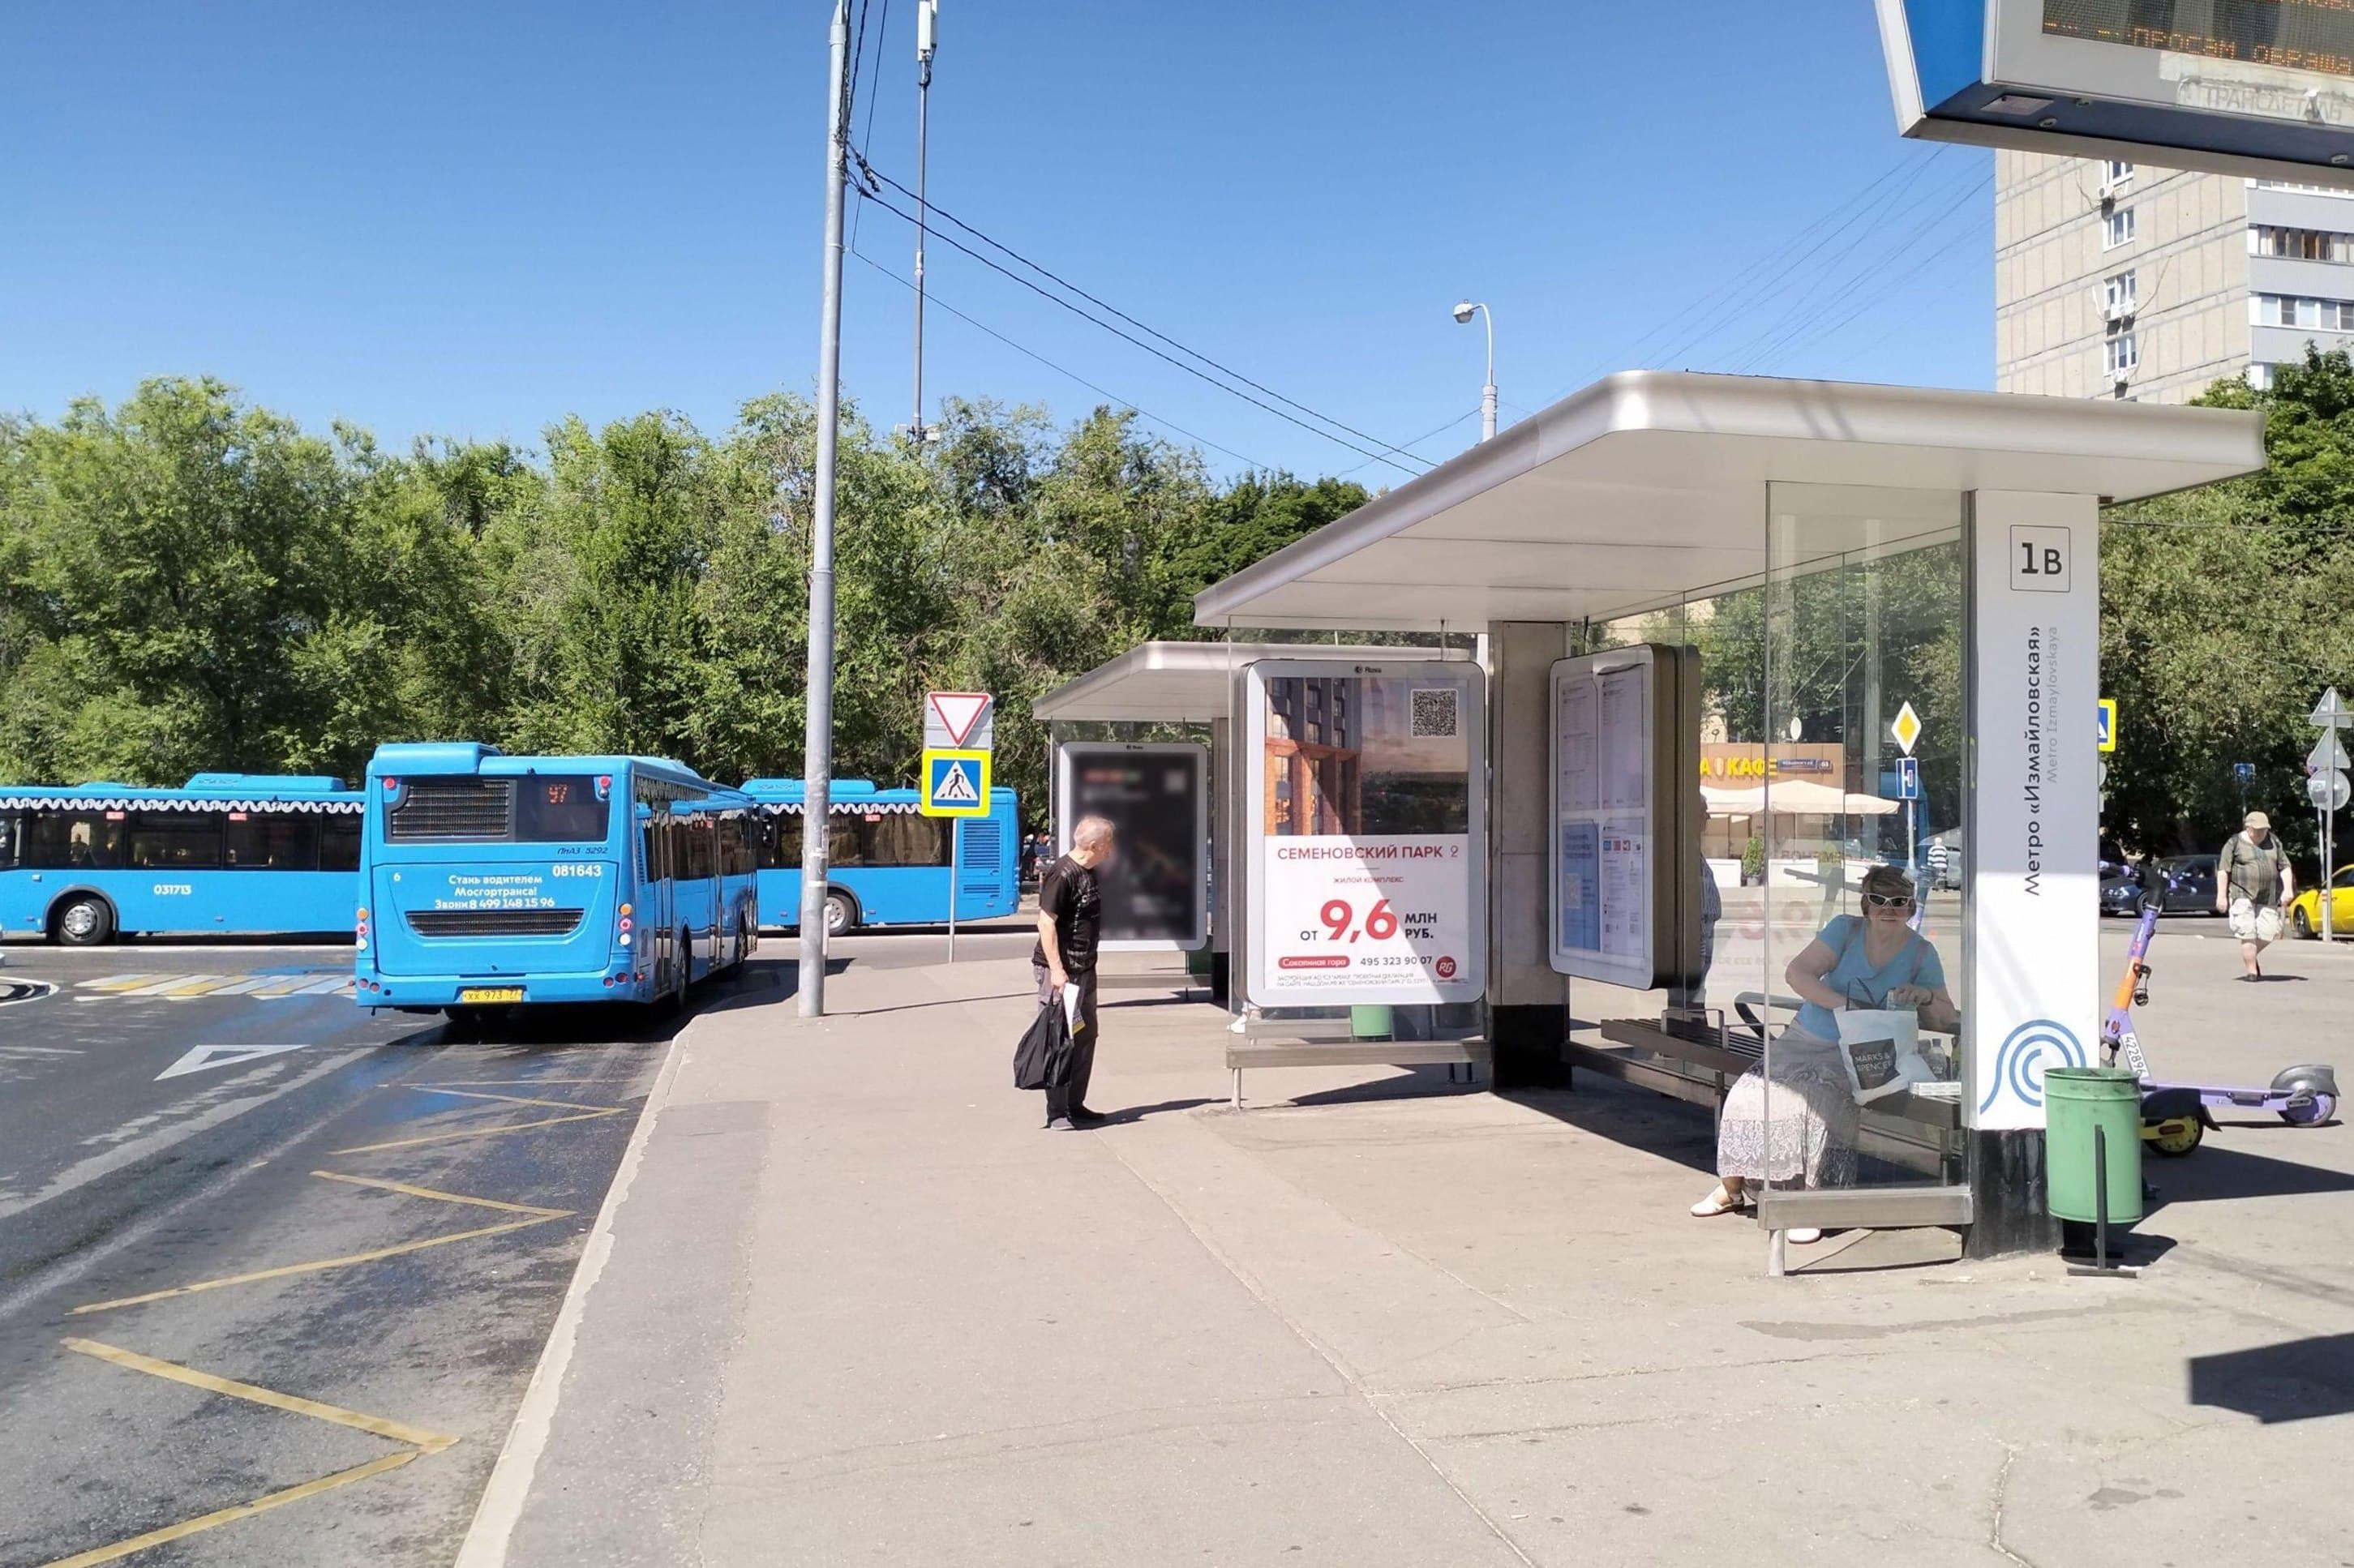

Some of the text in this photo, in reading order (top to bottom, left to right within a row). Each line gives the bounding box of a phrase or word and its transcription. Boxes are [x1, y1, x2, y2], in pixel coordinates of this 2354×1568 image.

[2047, 627, 2061, 784] Metro Izmaylovskaya
[1726, 757, 1778, 776] КАФЕ
[2023, 626, 2043, 897] Метро «Измайловская»
[1278, 845, 1398, 859] СЕМЕНОВСКИЙ
[1402, 846, 1443, 859] ПАРК
[393, 872, 401, 882] 6
[552, 865, 602, 877] 081643
[448, 875, 542, 885] Стань водителем
[454, 886, 537, 898] Мосгортранса!
[435, 898, 555, 909] Звони 8 499 148 15 96
[1300, 898, 1437, 944] ОТ 9,6 МЛН
[1404, 928, 1434, 940] РУБ.
[1383, 958, 1401, 966] 323
[1404, 957, 1417, 965] 90
[1420, 956, 1433, 965] 07
[2125, 1036, 2147, 1077] 422896
